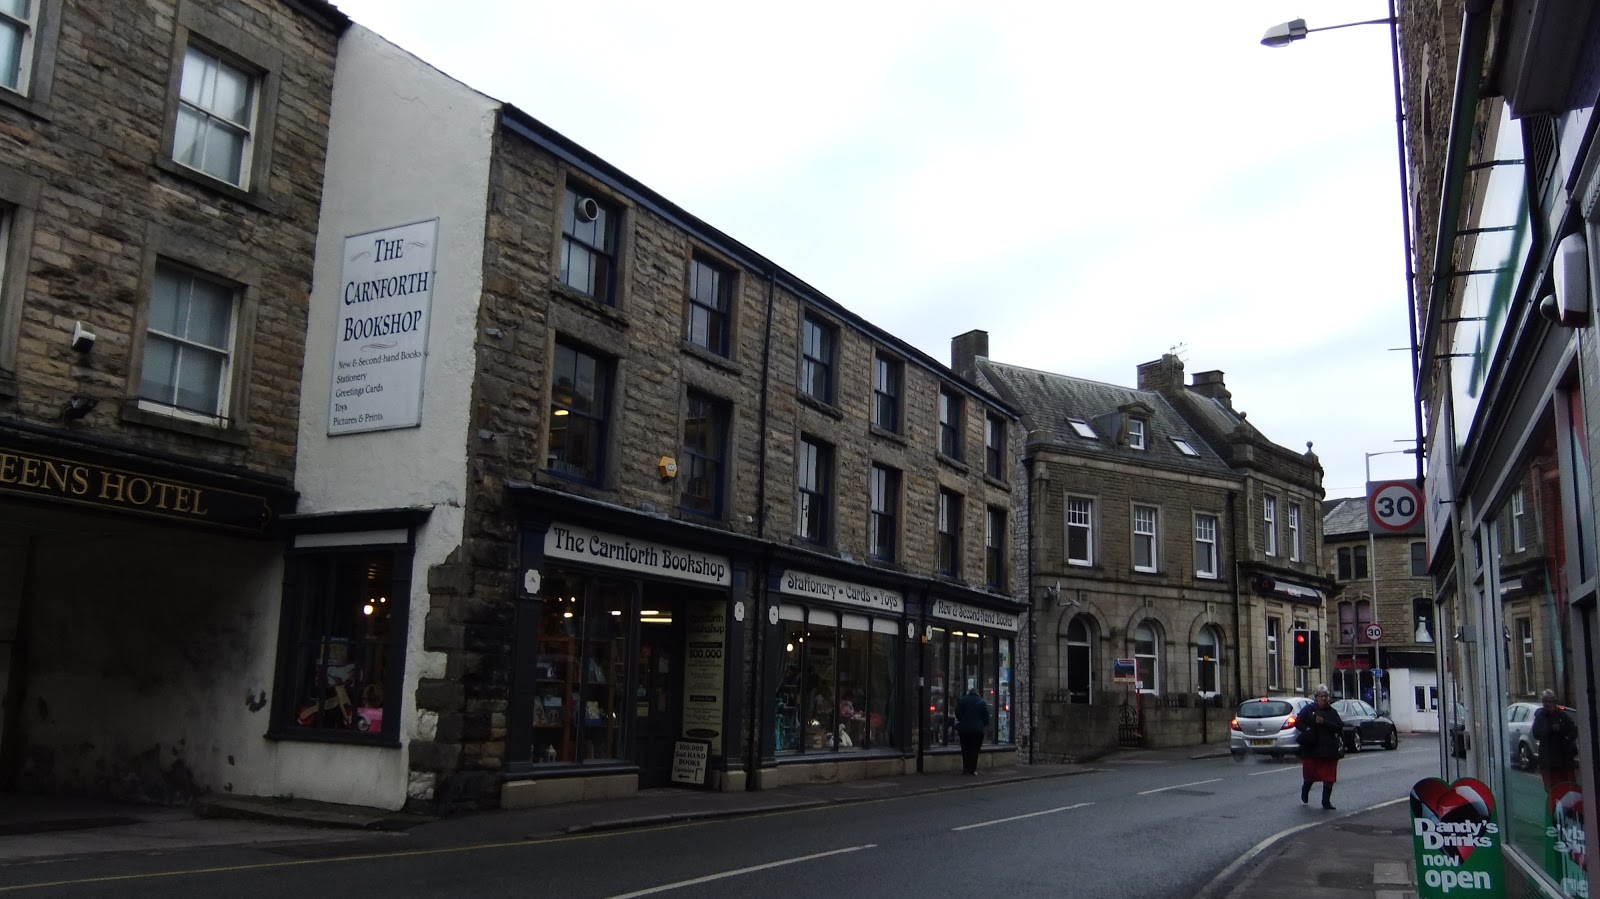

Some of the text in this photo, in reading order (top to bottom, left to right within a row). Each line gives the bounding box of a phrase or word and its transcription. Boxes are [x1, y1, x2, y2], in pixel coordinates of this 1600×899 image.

[374, 238, 404, 263] THE
[344, 271, 429, 306] CARNFORTH
[343, 310, 422, 342] BOOKSHOP
[338, 360, 352, 370] New
[358, 352, 400, 367] Second-hand
[401, 350, 422, 360] Books
[336, 372, 367, 384] Stationery
[335, 383, 384, 398] Greetings Cards
[334, 403, 348, 413] Toys
[333, 416, 357, 427] Pictures
[365, 413, 384, 423] Prints
[98, 471, 208, 516] HOTEL
[1378, 496, 1415, 518] 30
[553, 527, 725, 582] The Carnforth Bookshop
[787, 573, 898, 609] Stationery Cards Toys
[996, 612, 1013, 627] Books
[688, 624, 725, 635] okshop
[1368, 628, 1381, 637] 30
[678, 758, 701, 767] BOOKS
[1413, 817, 1499, 836] Dandy's
[1422, 831, 1493, 850] Drinks
[1423, 853, 1460, 867] now
[1424, 869, 1492, 894] open
